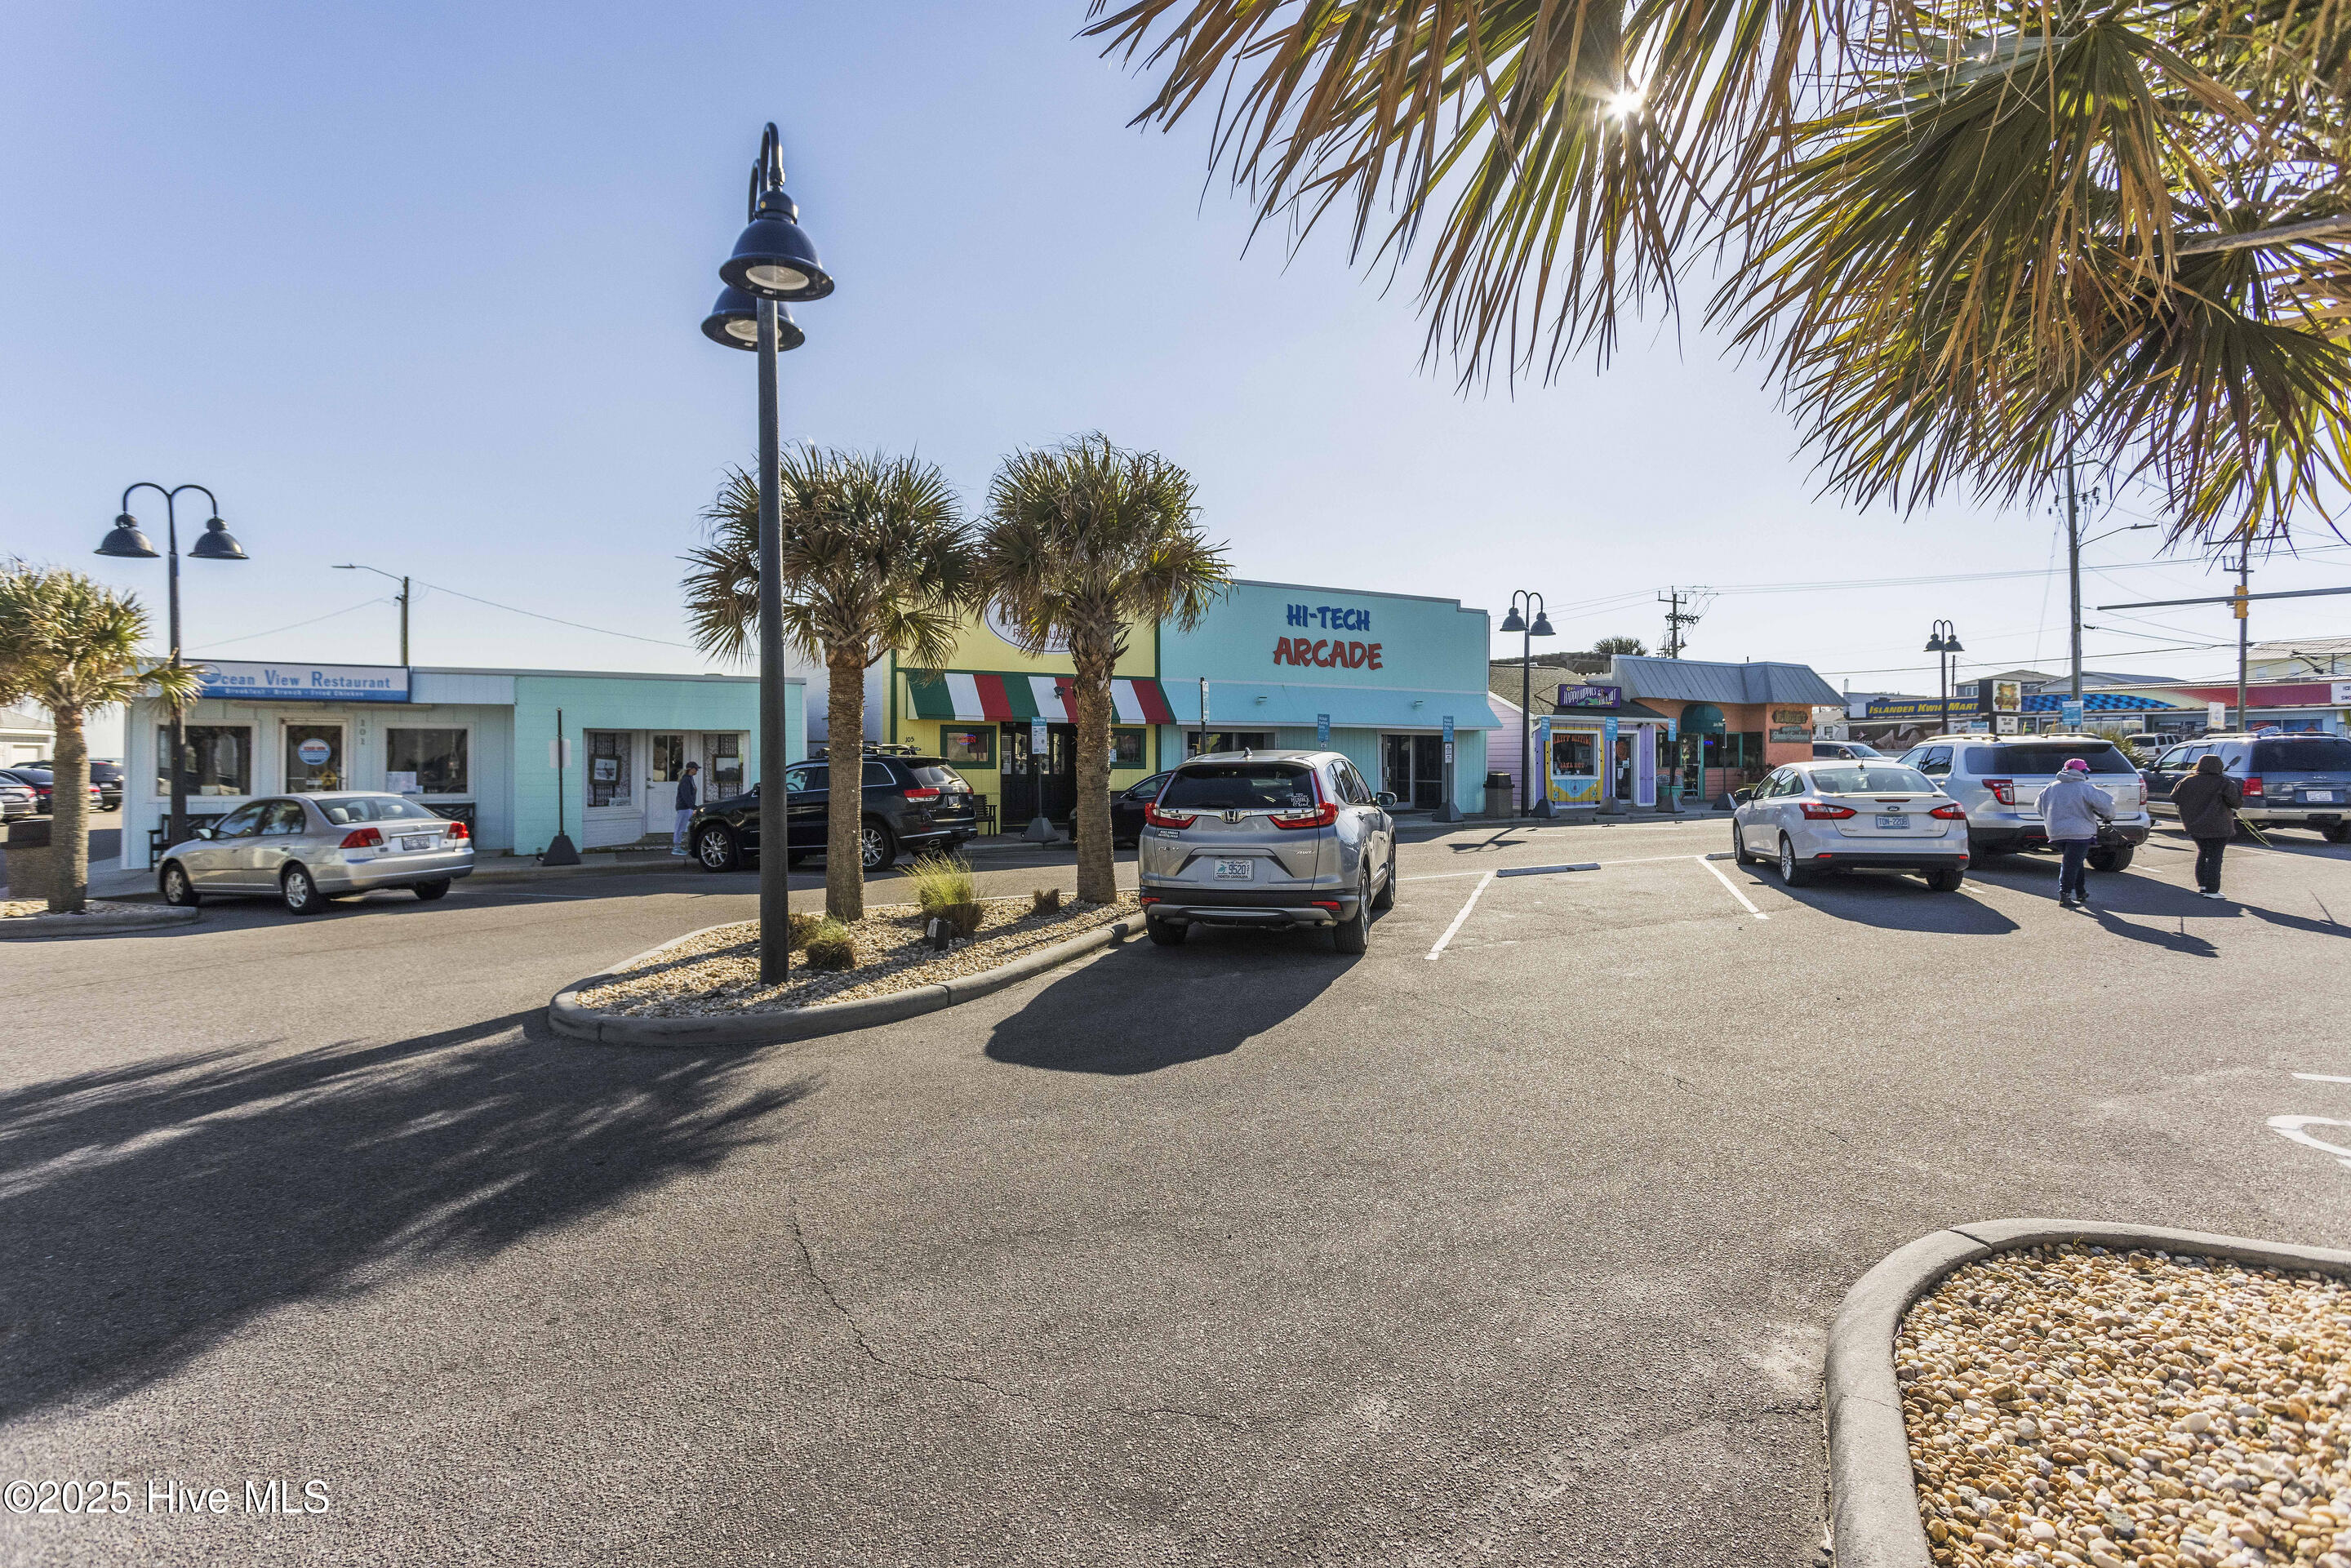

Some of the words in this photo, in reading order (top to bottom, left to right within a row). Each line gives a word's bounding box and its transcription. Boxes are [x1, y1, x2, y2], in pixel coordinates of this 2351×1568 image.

[1287, 603, 1371, 632] HI-TECH
[1273, 636, 1384, 670] ARCADE
[264, 669, 300, 686] View
[311, 670, 391, 688] Restaurant
[1869, 705, 1915, 714] ISLANDER
[1948, 702, 1979, 711] MART
[1229, 864, 1246, 875] 9520
